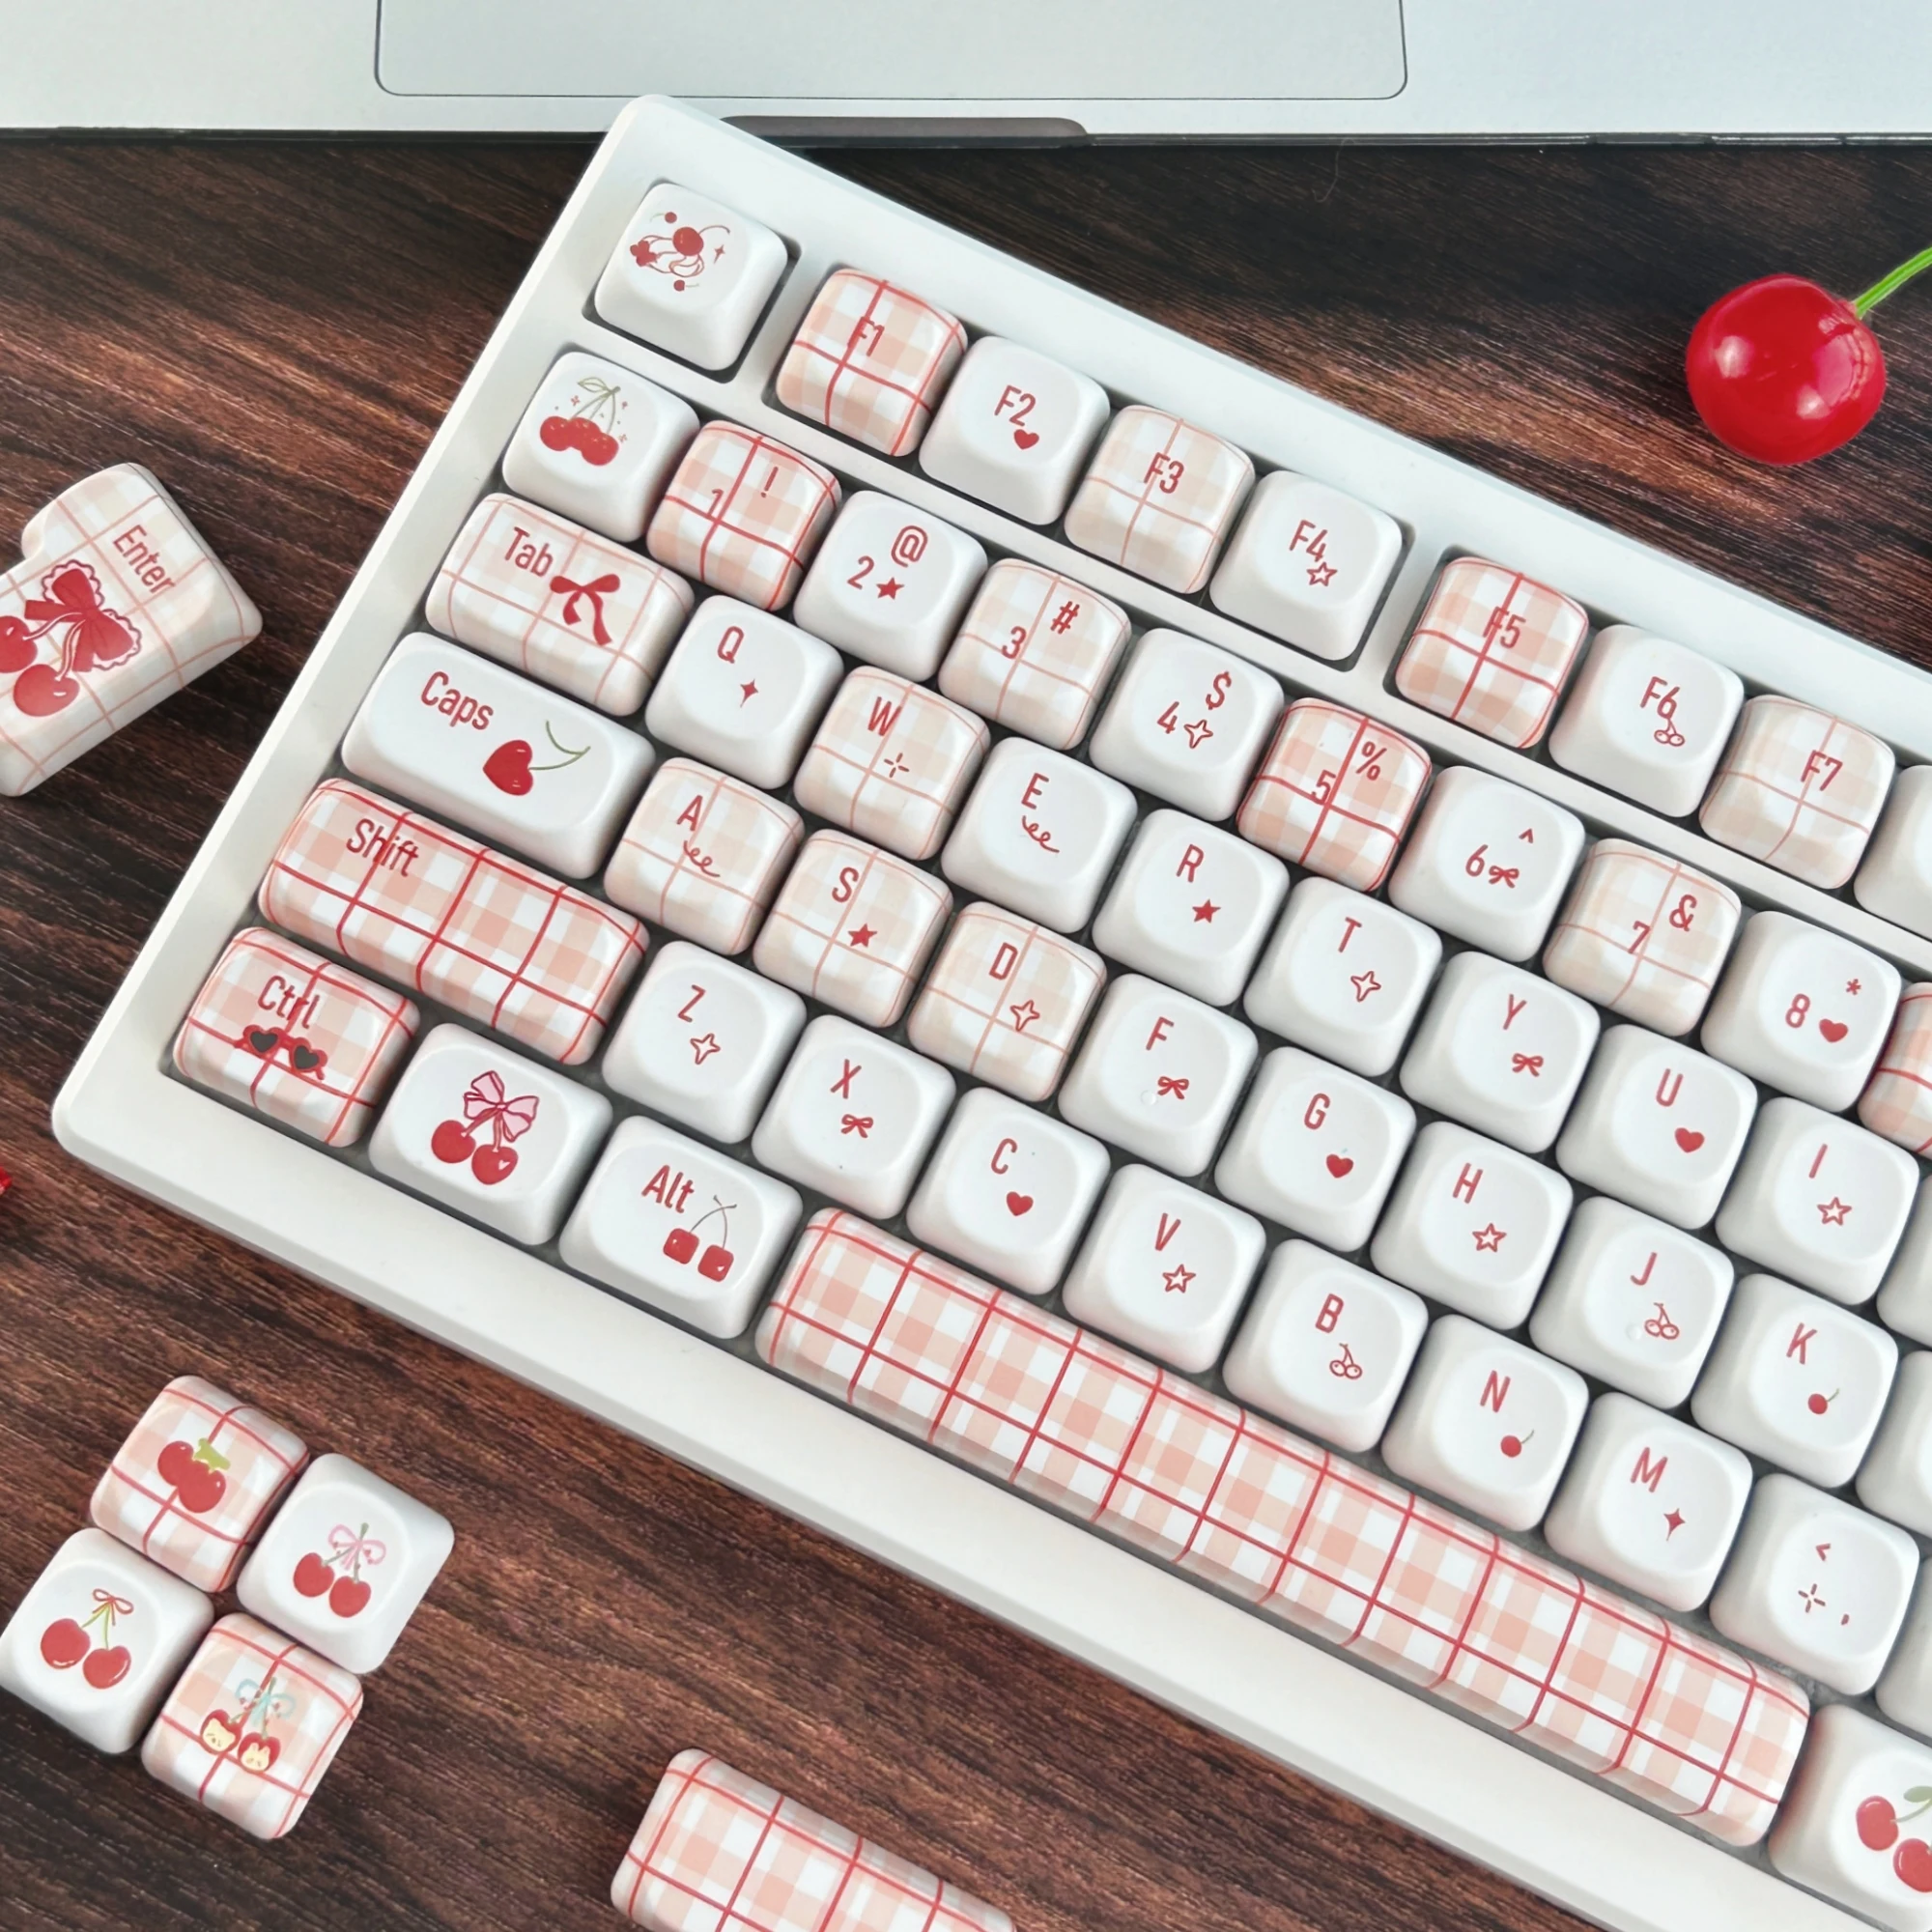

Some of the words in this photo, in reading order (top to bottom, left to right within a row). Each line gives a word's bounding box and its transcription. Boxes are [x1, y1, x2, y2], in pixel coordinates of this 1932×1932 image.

[847, 316, 885, 355] F1
[995, 385, 1036, 427] F2
[759, 467, 779, 497] !
[1144, 452, 1184, 494] F3
[706, 490, 724, 517] 1
[112, 525, 174, 594] Enter
[504, 527, 554, 578] Tab
[891, 526, 927, 567] @
[1291, 520, 1326, 561] F4
[848, 556, 874, 588] 2
[1051, 601, 1080, 635] #
[1483, 608, 1525, 648] F5
[718, 626, 744, 664] Q
[1002, 626, 1027, 658] 3
[420, 671, 493, 730] Caps
[1206, 671, 1232, 710] $
[1640, 676, 1680, 718] F6
[867, 697, 902, 736] W
[1157, 702, 1178, 733] 4
[1355, 742, 1387, 781] %
[1800, 750, 1843, 791] F7
[1021, 773, 1047, 809] E
[1311, 771, 1335, 804] 5
[677, 796, 704, 831] A
[347, 818, 419, 877] Shift
[1177, 844, 1204, 882] R
[1465, 846, 1486, 876] 6
[832, 867, 858, 902] S
[1669, 894, 1698, 932] &
[1340, 918, 1361, 952] T
[1627, 923, 1651, 954] 7
[989, 943, 1018, 980] D
[257, 976, 320, 1029] Ctrl
[678, 985, 706, 1021] Z
[1504, 996, 1525, 1029] Y
[1785, 994, 1810, 1028] 8
[1147, 1017, 1174, 1049] F
[832, 1060, 860, 1098] X
[1656, 1070, 1683, 1107] U
[1304, 1094, 1330, 1130] G
[991, 1138, 1017, 1175] C
[1809, 1146, 1828, 1179] I
[642, 1165, 694, 1213] Alt
[1453, 1164, 1482, 1203] H
[1155, 1213, 1180, 1251] V
[1633, 1253, 1657, 1286] J
[1316, 1294, 1345, 1333] B
[1787, 1325, 1815, 1363] K
[1481, 1371, 1511, 1413] N
[1632, 1448, 1667, 1491] M
